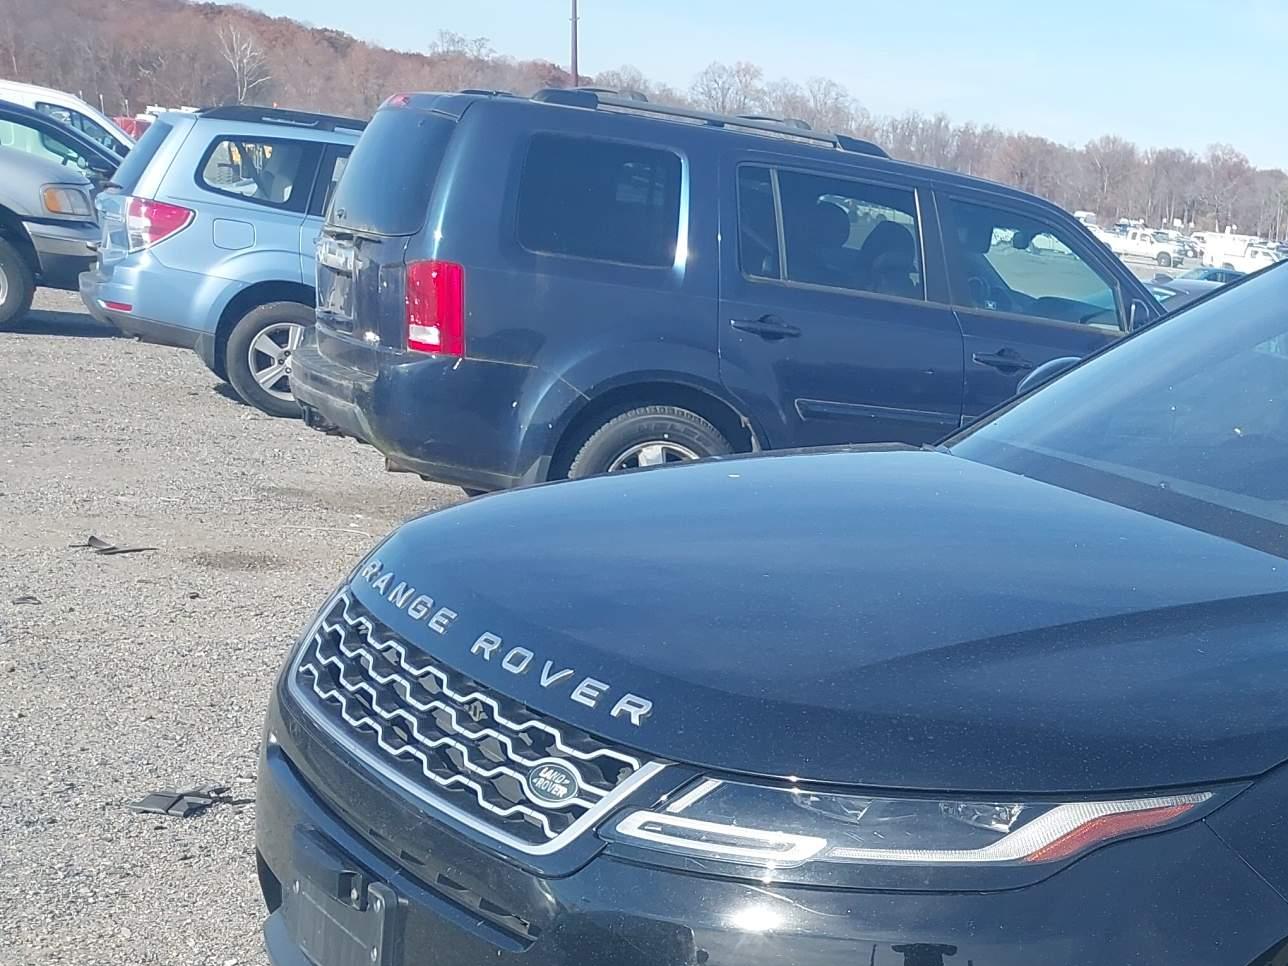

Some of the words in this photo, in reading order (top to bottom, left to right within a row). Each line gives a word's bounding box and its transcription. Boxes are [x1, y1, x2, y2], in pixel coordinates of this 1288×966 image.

[361, 559, 458, 634] RANGE
[470, 631, 654, 727] ROVER
[538, 766, 567, 784] LAND
[534, 777, 568, 798] ROVER
